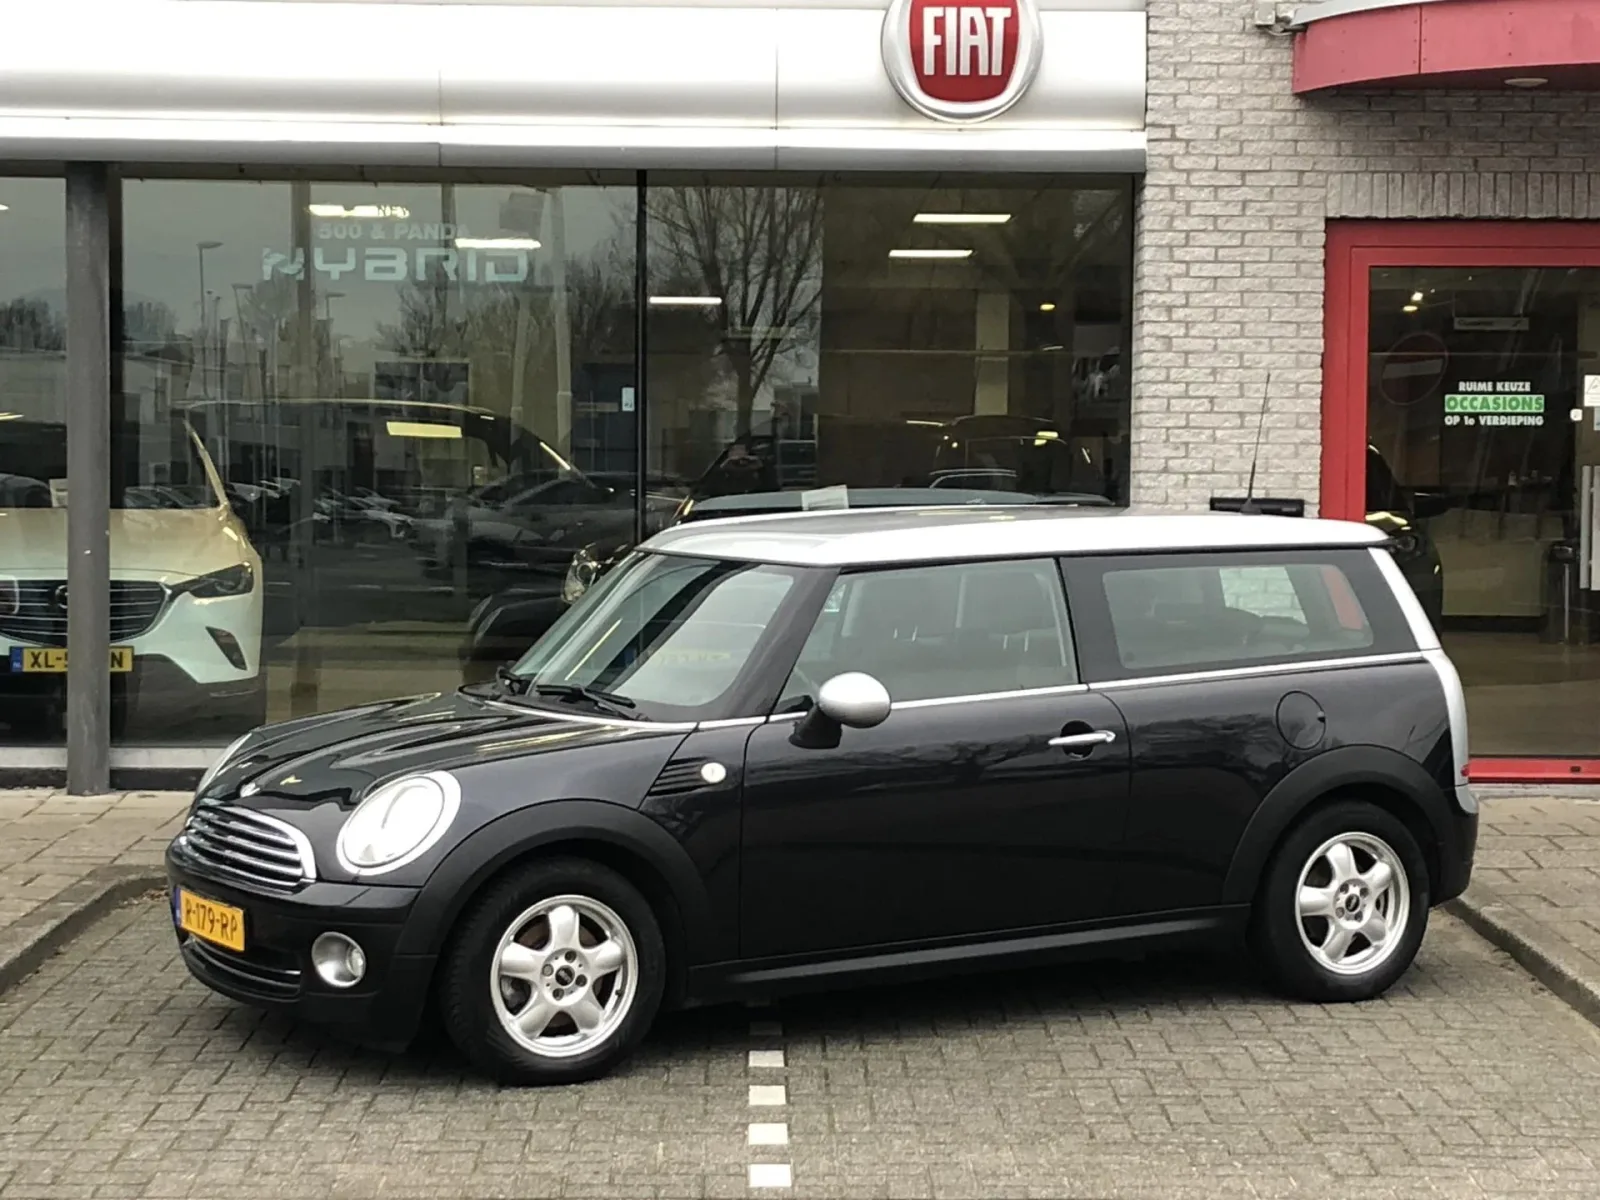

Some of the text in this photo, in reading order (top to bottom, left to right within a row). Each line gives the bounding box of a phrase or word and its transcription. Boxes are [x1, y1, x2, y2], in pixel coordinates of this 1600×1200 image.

[923, 6, 1012, 76] FIAT
[318, 222, 470, 240] 500 & PANDA
[1458, 382, 1531, 392] RUIME KEUZE
[1446, 396, 1543, 411] OCCASIONS
[1444, 416, 1460, 426] OP
[1479, 416, 1544, 426] VERDIEPING
[185, 898, 238, 941] R-179-RP
